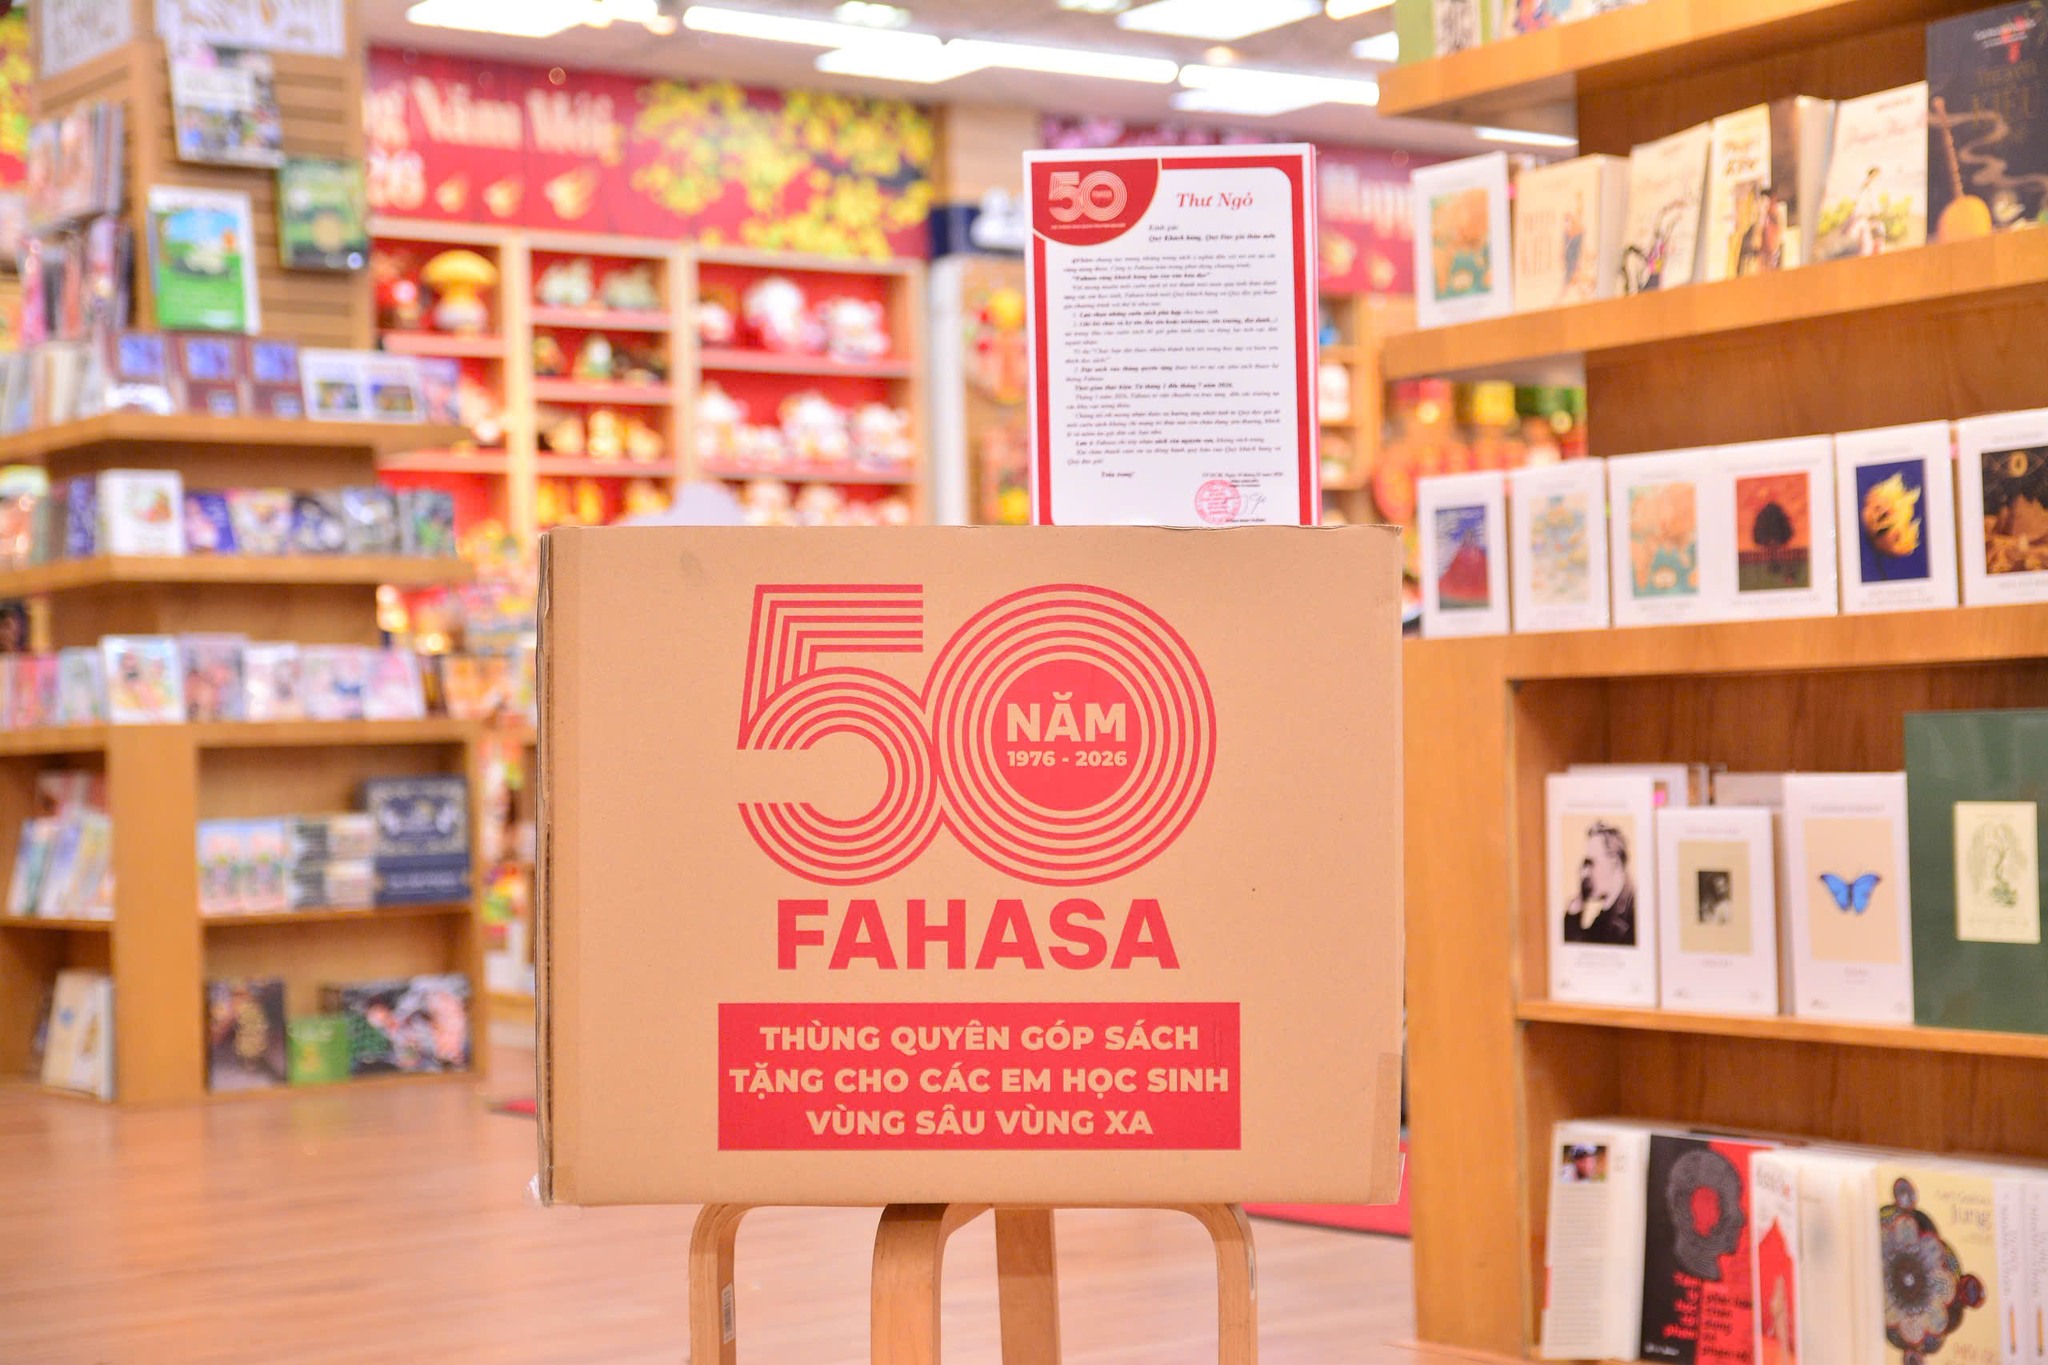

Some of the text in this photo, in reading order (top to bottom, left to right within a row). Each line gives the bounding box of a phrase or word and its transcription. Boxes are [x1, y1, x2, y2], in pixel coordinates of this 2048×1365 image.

[1049, 170, 1128, 223] 50
[1176, 193, 1213, 208] Thư
[737, 584, 1216, 887] 50
[1007, 691, 1127, 742] NĂM
[1007, 750, 1056, 767] 1976
[1075, 750, 1128, 767] 2026
[778, 898, 1180, 970] FAHASA
[760, 1019, 1199, 1057] THÙNG QUYÊN GÓP SÁCH
[729, 1062, 1229, 1100] TẶNG CHO CÁC EM HỌC SINH
[806, 1104, 1153, 1136] VÙNG SÂU VÙNG XA
